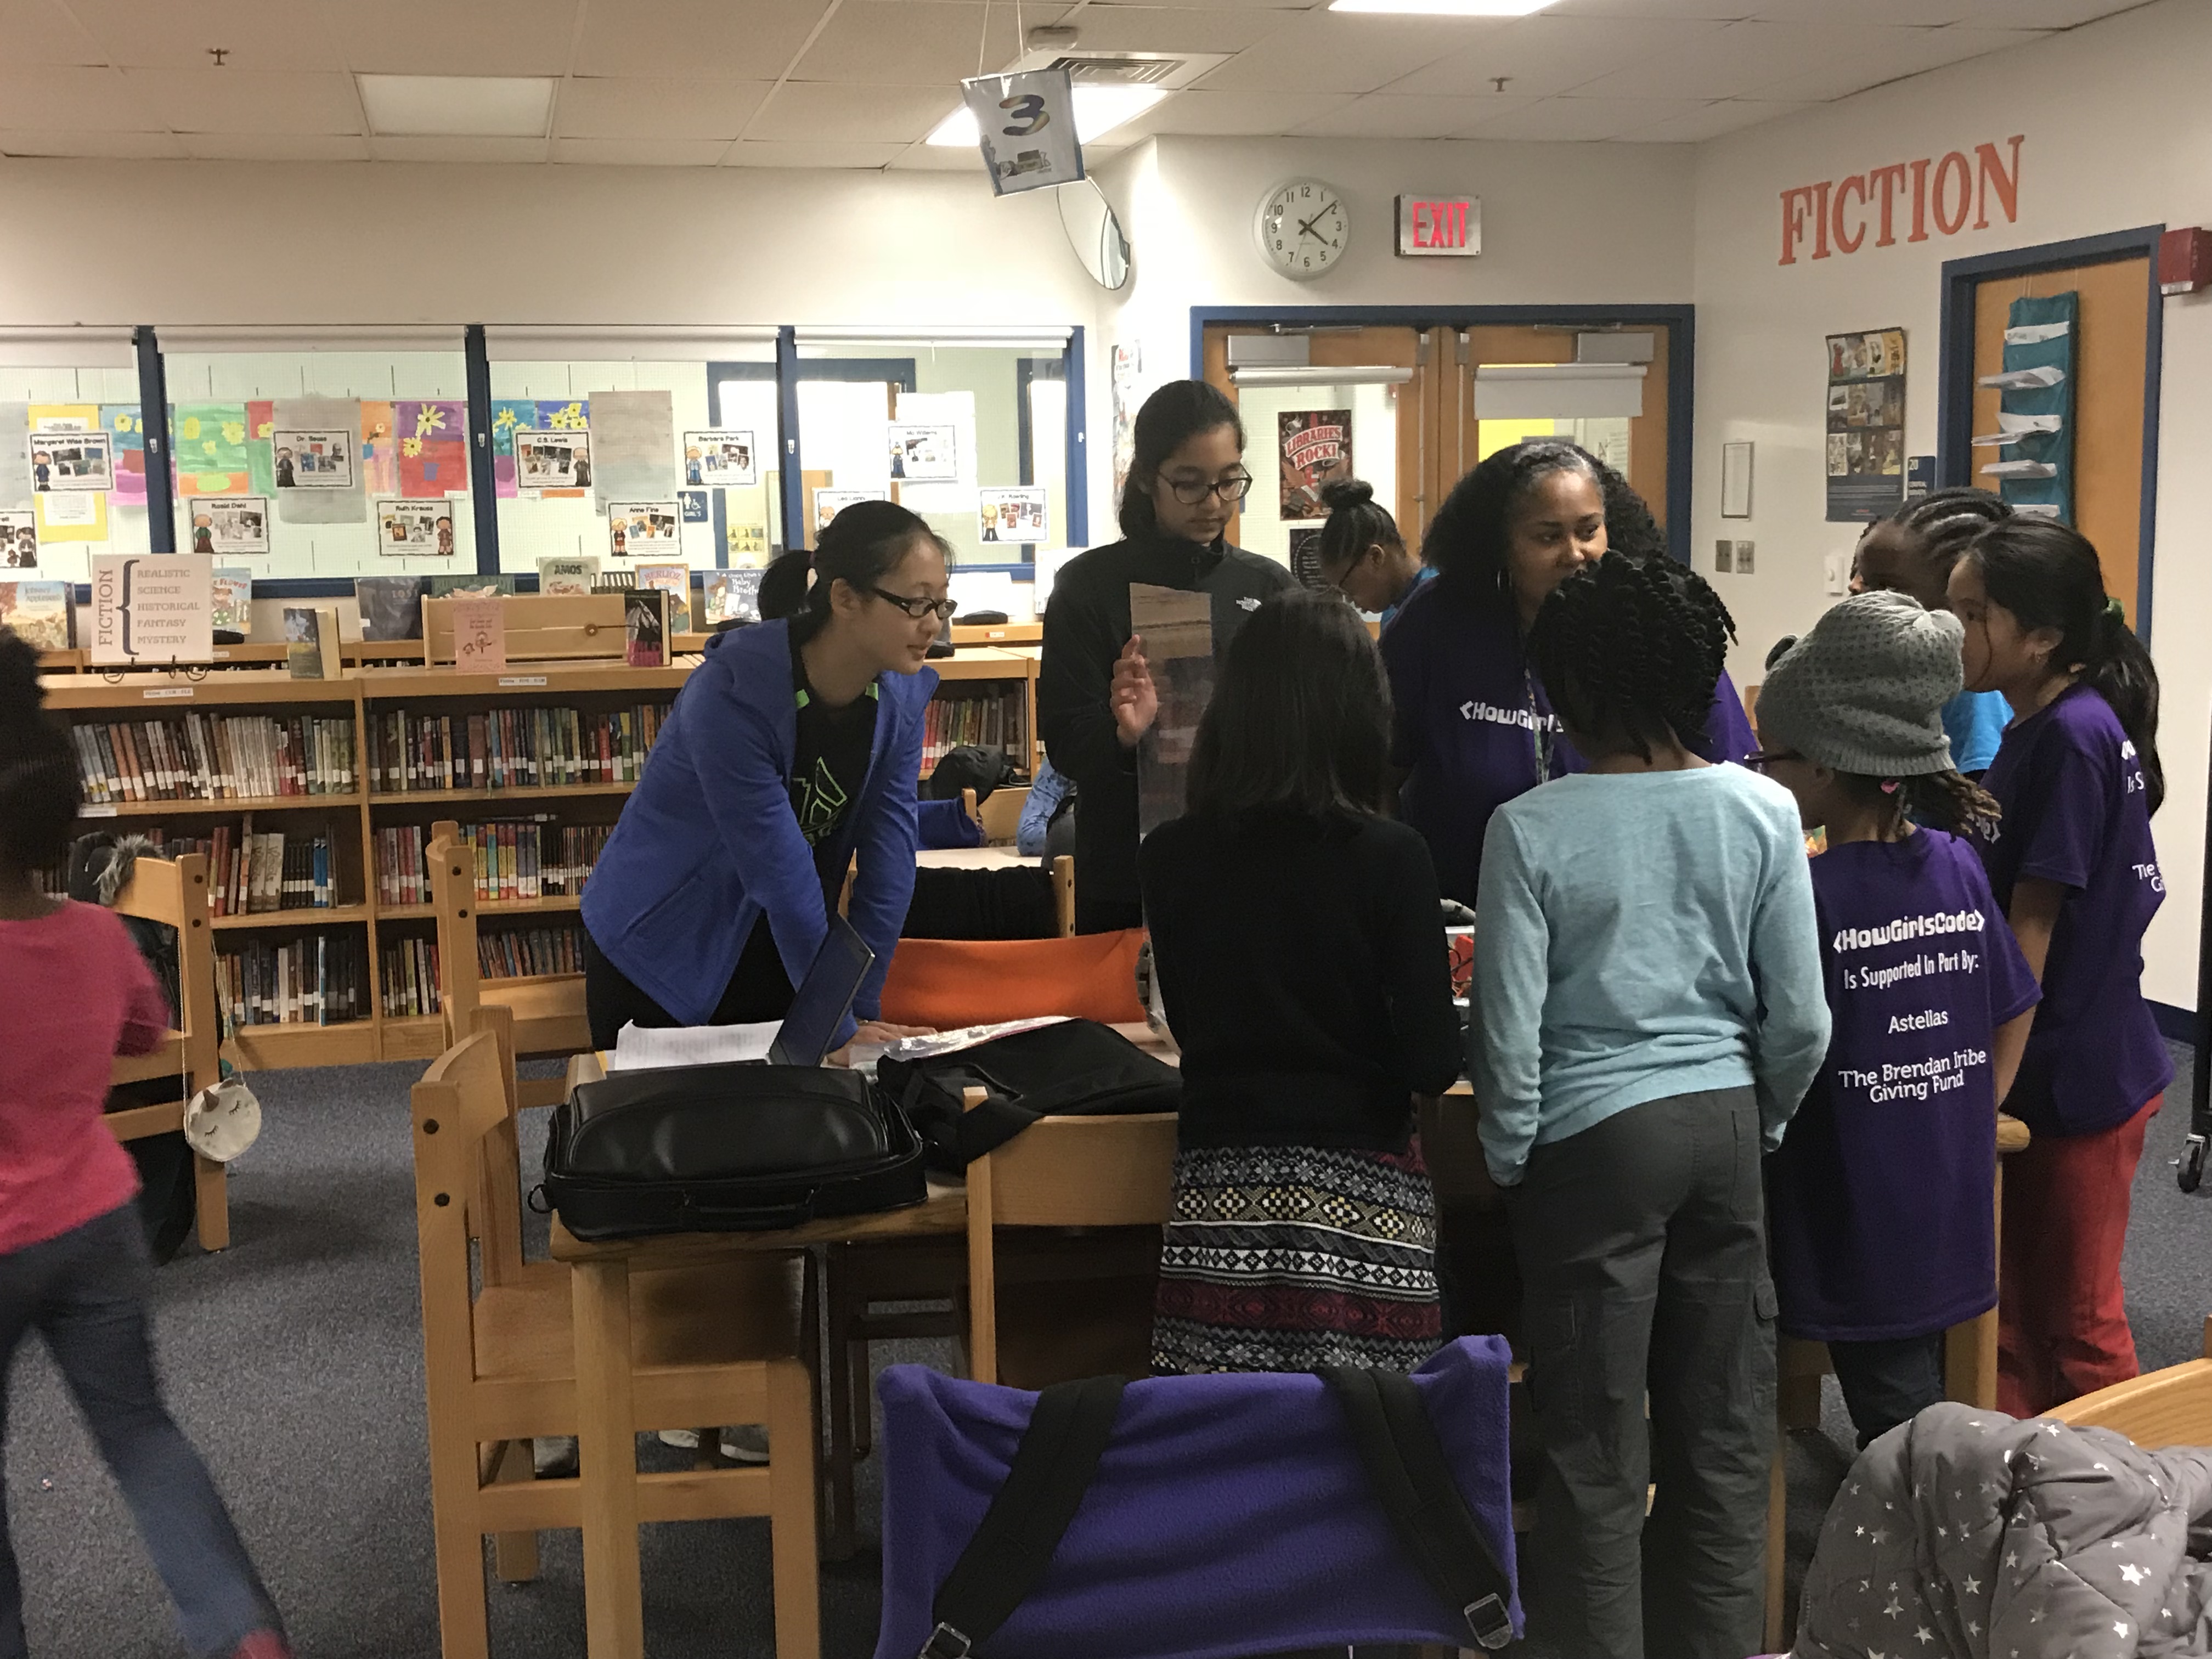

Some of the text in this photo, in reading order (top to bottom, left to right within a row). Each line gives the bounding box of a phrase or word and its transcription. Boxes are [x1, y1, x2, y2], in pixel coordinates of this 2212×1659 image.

[999, 94, 1050, 136] 3
[1286, 191, 1294, 202] 11
[1301, 187, 1310, 198] 12
[1321, 191, 1323, 202] 1
[1778, 134, 2024, 266] FICTION
[1274, 205, 1283, 216] 10
[1331, 204, 1337, 215] 2
[1271, 222, 1278, 233] 9
[1336, 221, 1342, 232] 3
[1412, 202, 1470, 247] EXIT
[1276, 239, 1282, 250] 8
[1331, 239, 1338, 249] 4
[1288, 251, 1294, 262] 7
[1320, 251, 1327, 261] 5
[1304, 257, 1310, 267] 6
[1286, 427, 1342, 455] LIBRARIES
[137, 569, 190, 578] REALISTIC
[554, 565, 582, 575] AMOS
[644, 569, 681, 580] BERLIOZ
[137, 586, 182, 595] SCIENCE
[392, 589, 419, 599] LOST
[99, 569, 113, 646] FICTION
[137, 602, 201, 611] HISTORICAL
[137, 619, 187, 628] FANTASY
[137, 635, 187, 644] MYSTERY
[1844, 950, 1979, 990] Is Supported In Part By:
[1888, 1009, 1948, 1034] Astellas
[1838, 1048, 1986, 1088] The Brendan Iribe
[1870, 1069, 1965, 1103] Giving Fund
